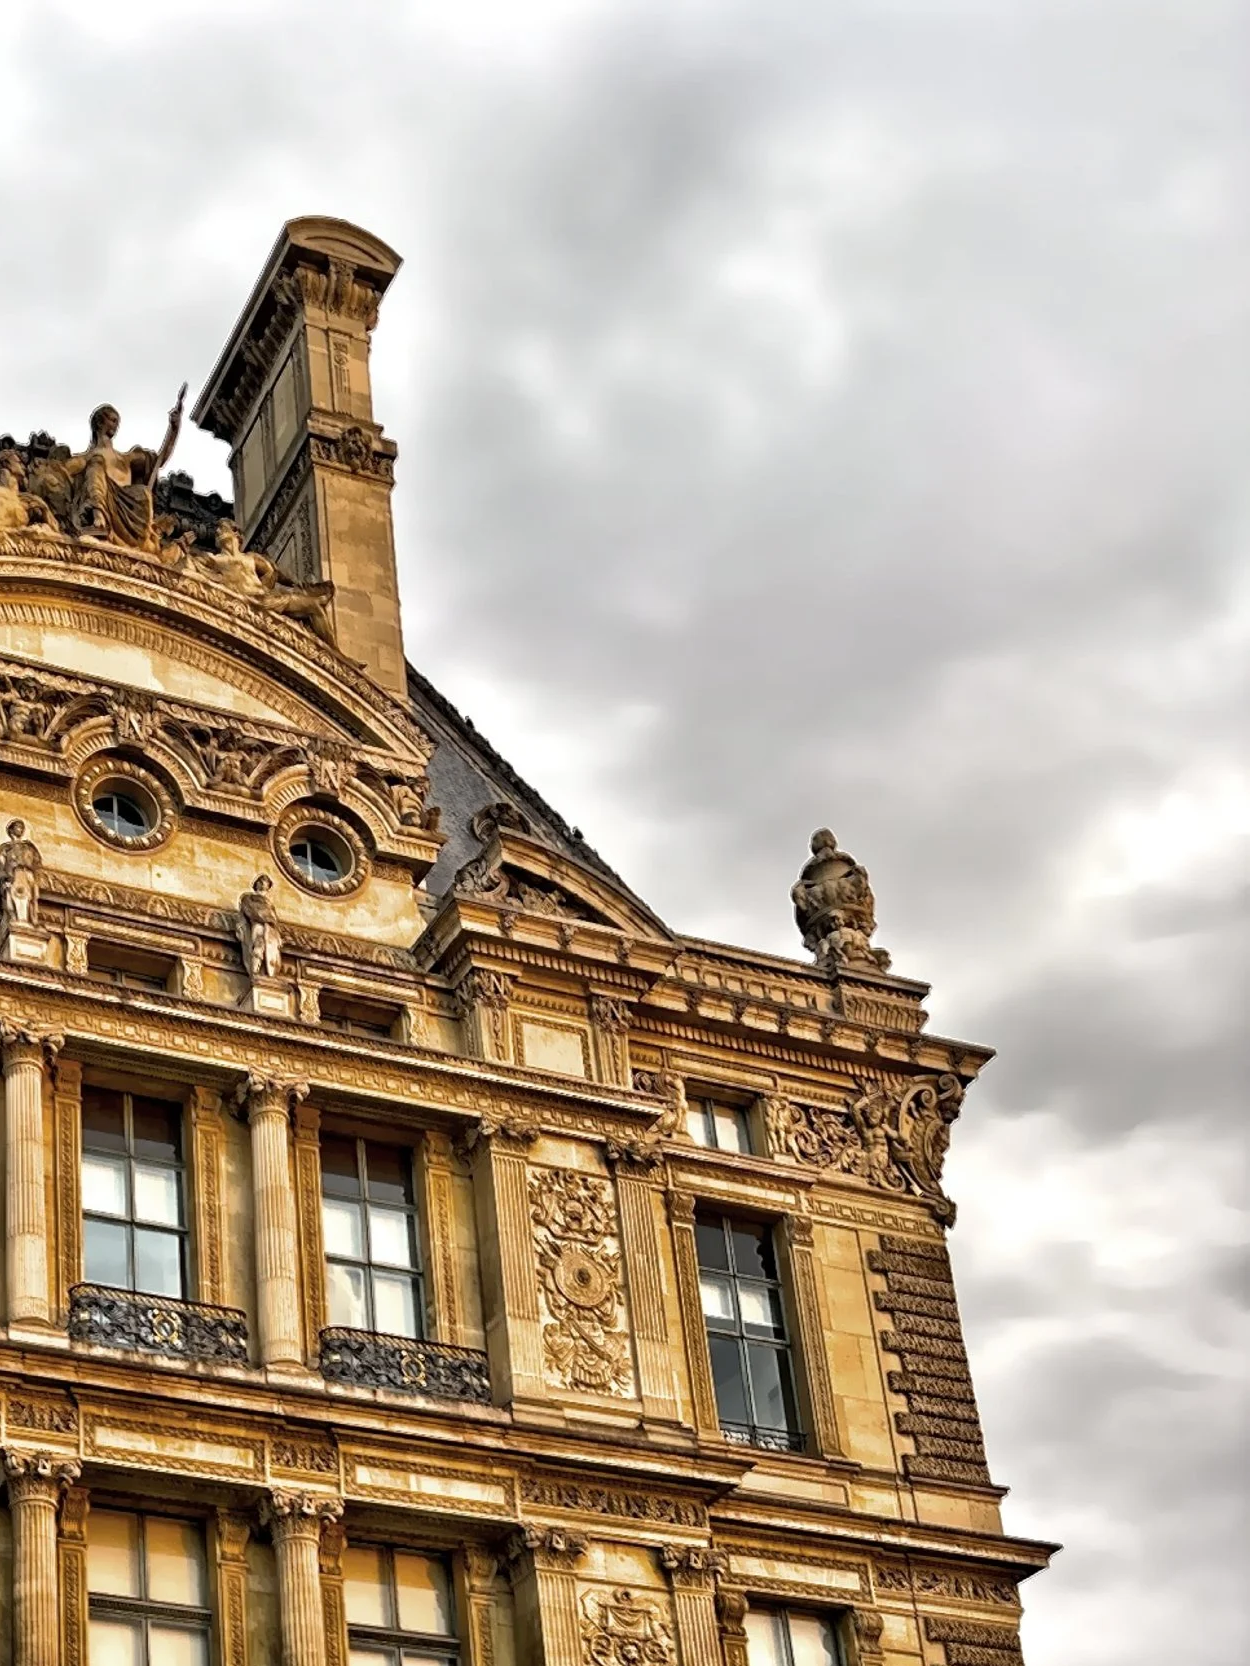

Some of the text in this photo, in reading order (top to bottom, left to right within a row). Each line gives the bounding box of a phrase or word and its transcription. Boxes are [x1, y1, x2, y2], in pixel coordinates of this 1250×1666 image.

[124, 709, 146, 740] N
[320, 759, 341, 789] N
[490, 973, 504, 995] N
[37, 1458, 52, 1477] N
[552, 1533, 566, 1550] N
[689, 1552, 703, 1570] N
